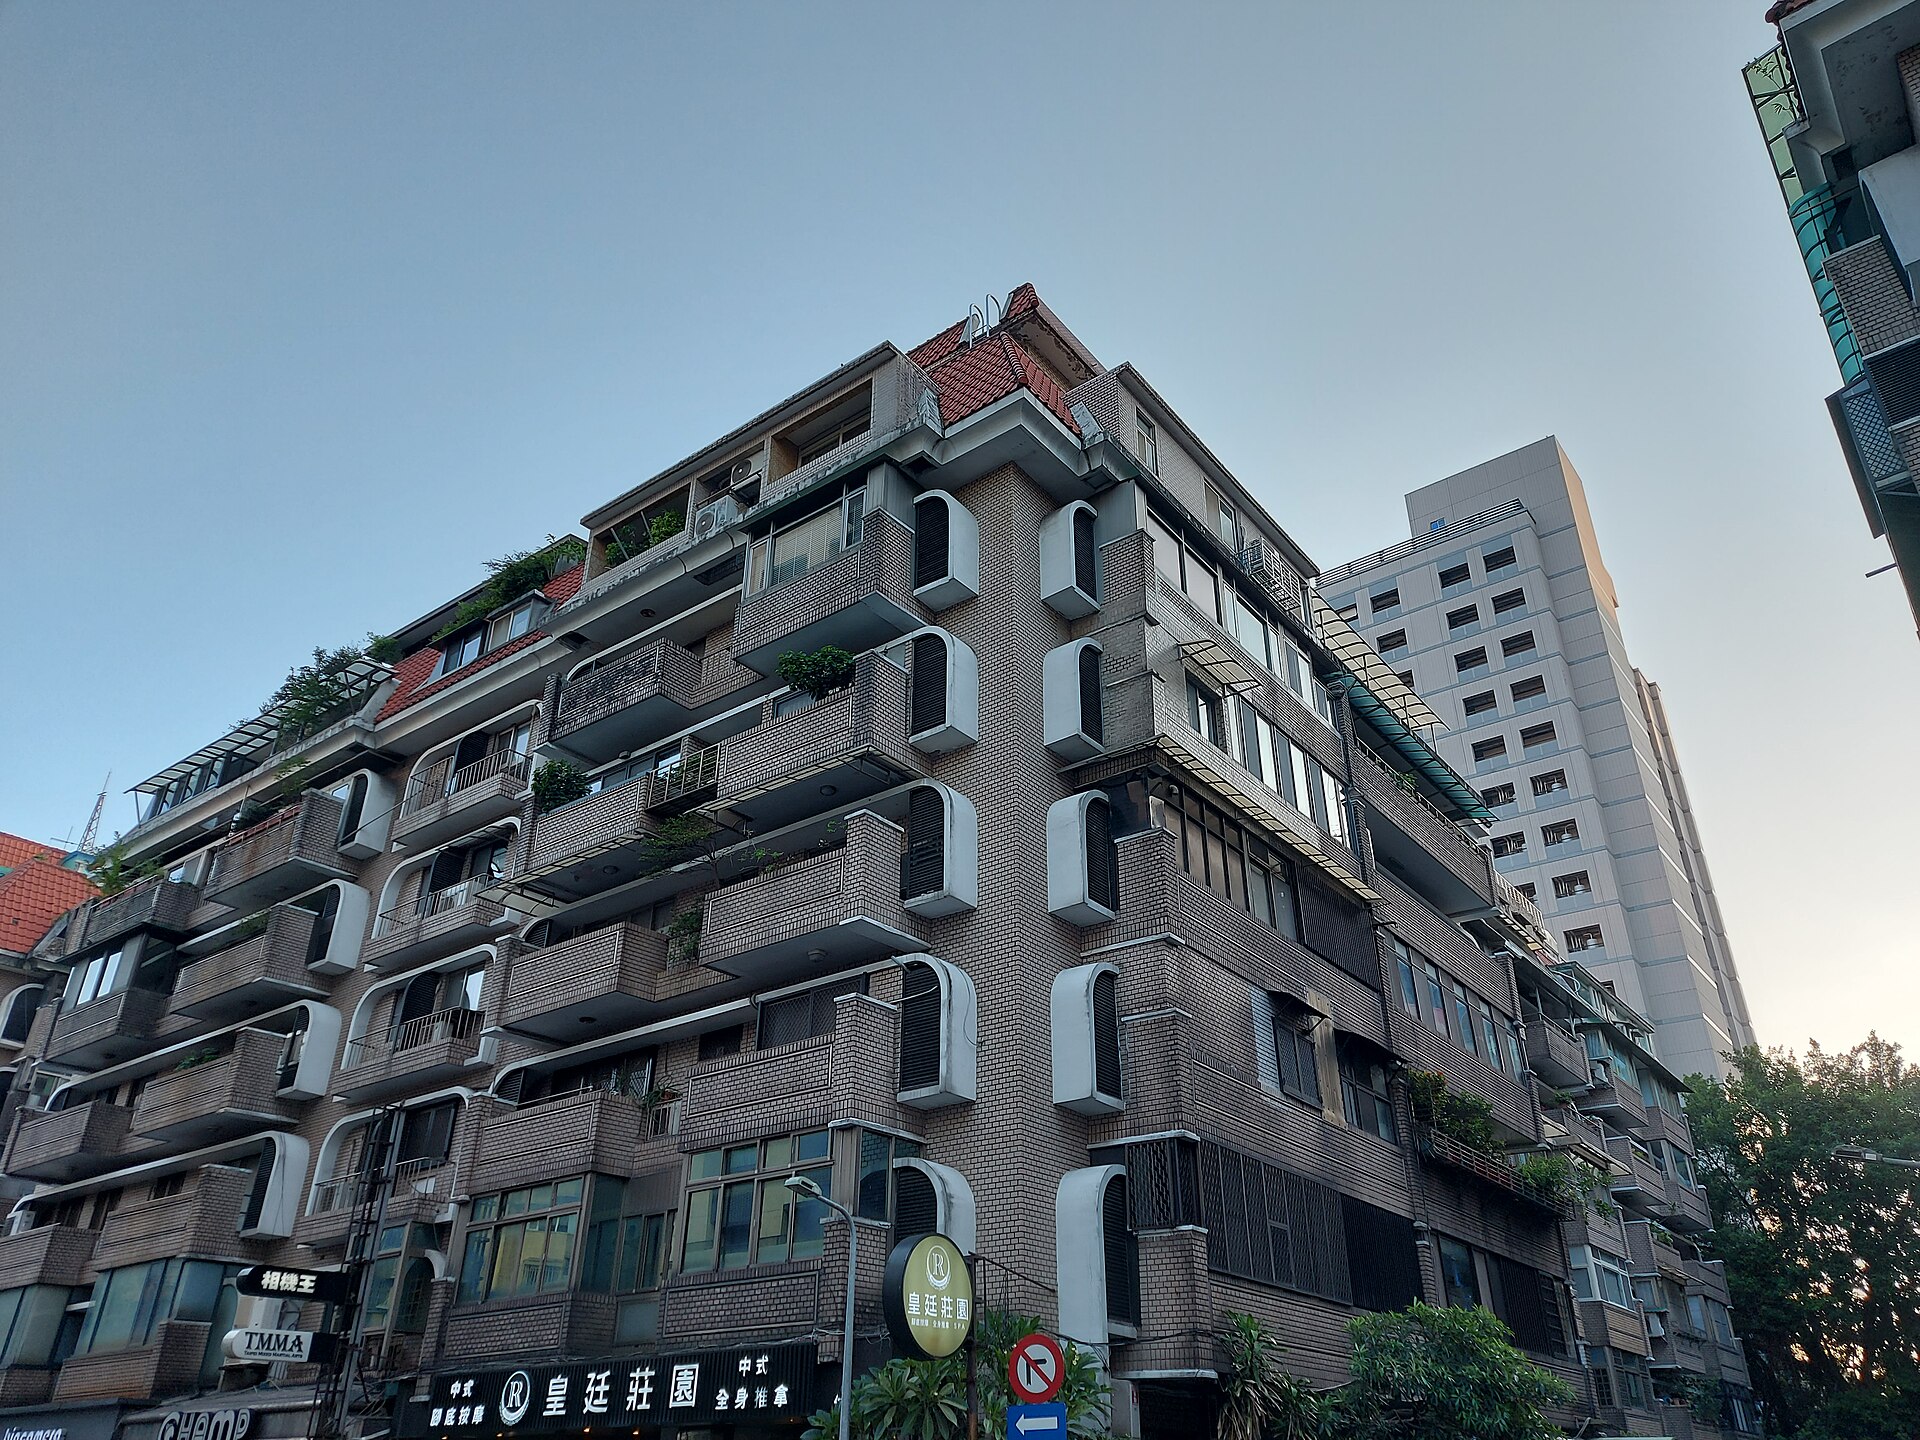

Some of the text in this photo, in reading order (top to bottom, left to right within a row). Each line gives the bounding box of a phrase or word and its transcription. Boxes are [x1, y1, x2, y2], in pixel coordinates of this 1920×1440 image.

[261, 1270, 317, 1294] 相機王
[907, 1291, 969, 1321] 皇廷莊園
[245, 1332, 304, 1353] TMMA
[738, 1354, 769, 1377] 中式
[450, 1379, 475, 1399] 中式
[542, 1363, 700, 1416] 皇廷莊園
[715, 1384, 789, 1410] 全身推拿
